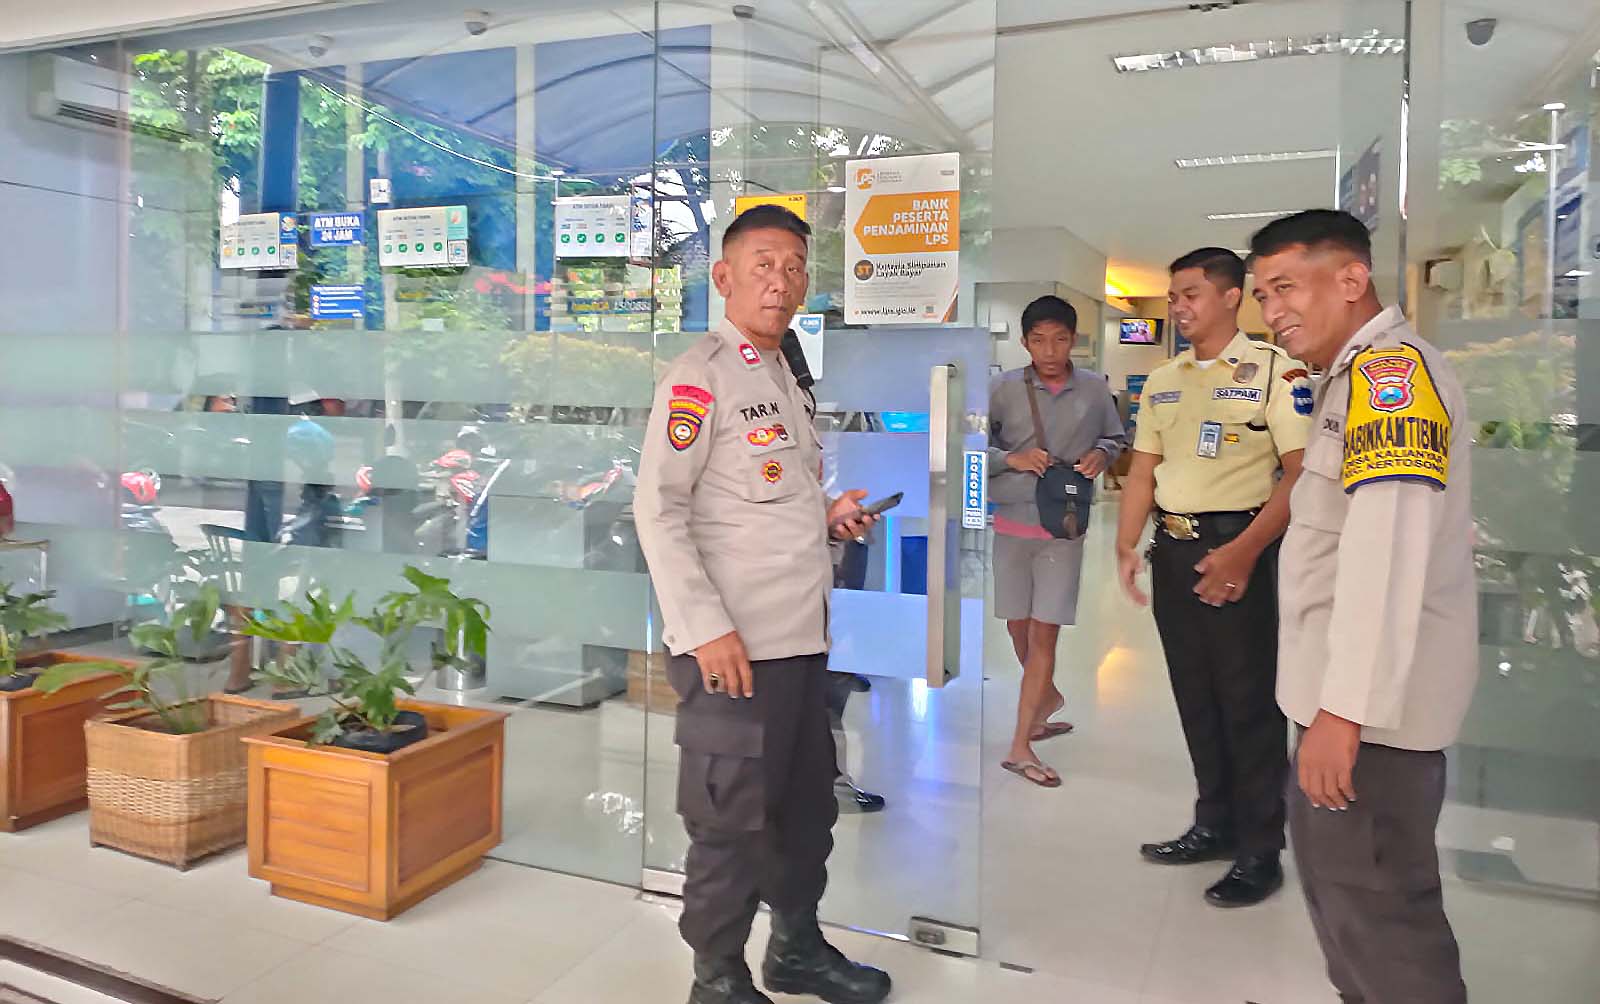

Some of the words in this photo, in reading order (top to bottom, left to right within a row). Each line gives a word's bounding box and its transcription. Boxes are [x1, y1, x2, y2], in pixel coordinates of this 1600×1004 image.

[912, 198, 949, 211] BANK
[314, 217, 334, 228] ATM
[334, 215, 360, 227] BUKA
[892, 209, 949, 223] PESERTA
[334, 229, 353, 241] JAM
[862, 221, 949, 237] PENJAMINAN
[925, 233, 949, 246] LPS
[906, 258, 947, 270] Simpanan
[875, 269, 899, 279] Layak
[899, 267, 922, 279] Bayar
[1215, 388, 1259, 401] SATPAM
[969, 455, 979, 508] DORONG
